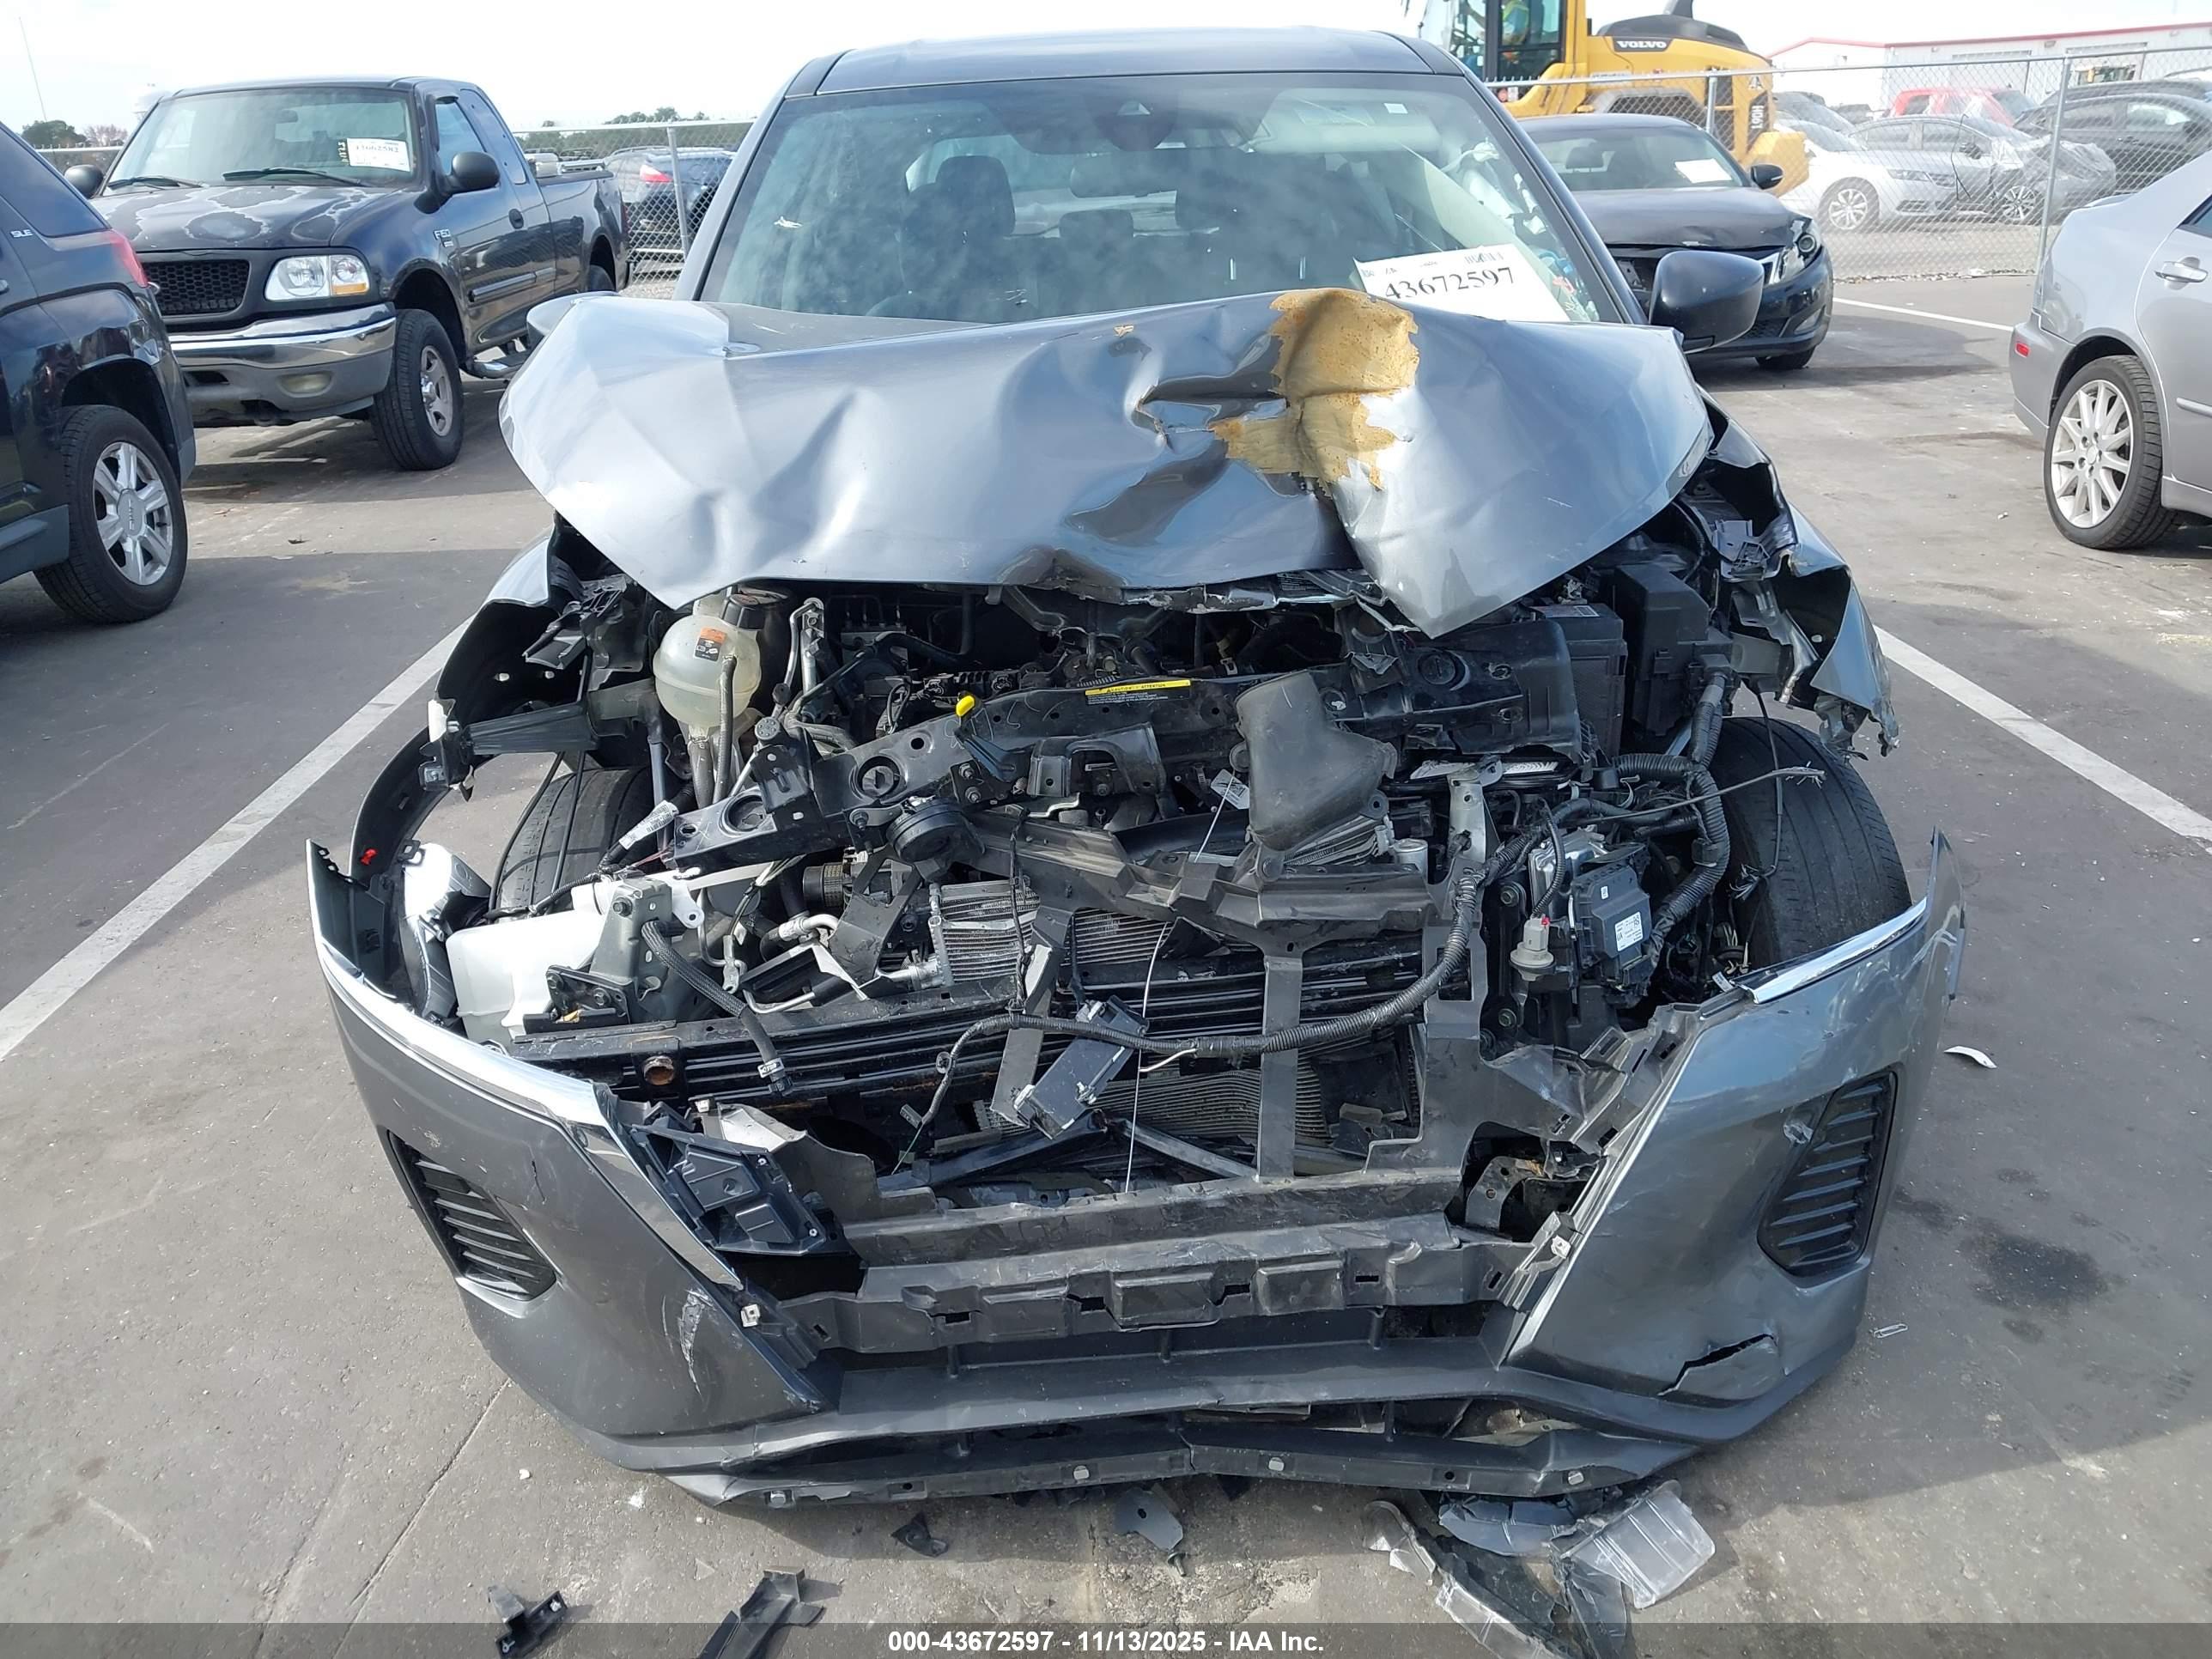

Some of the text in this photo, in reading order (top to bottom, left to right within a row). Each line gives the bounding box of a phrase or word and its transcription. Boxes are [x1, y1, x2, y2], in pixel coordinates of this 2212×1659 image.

[1616, 40, 1667, 49] VOLVO
[10, 228, 33, 238] SLE
[1385, 266, 1514, 300] 43672597
